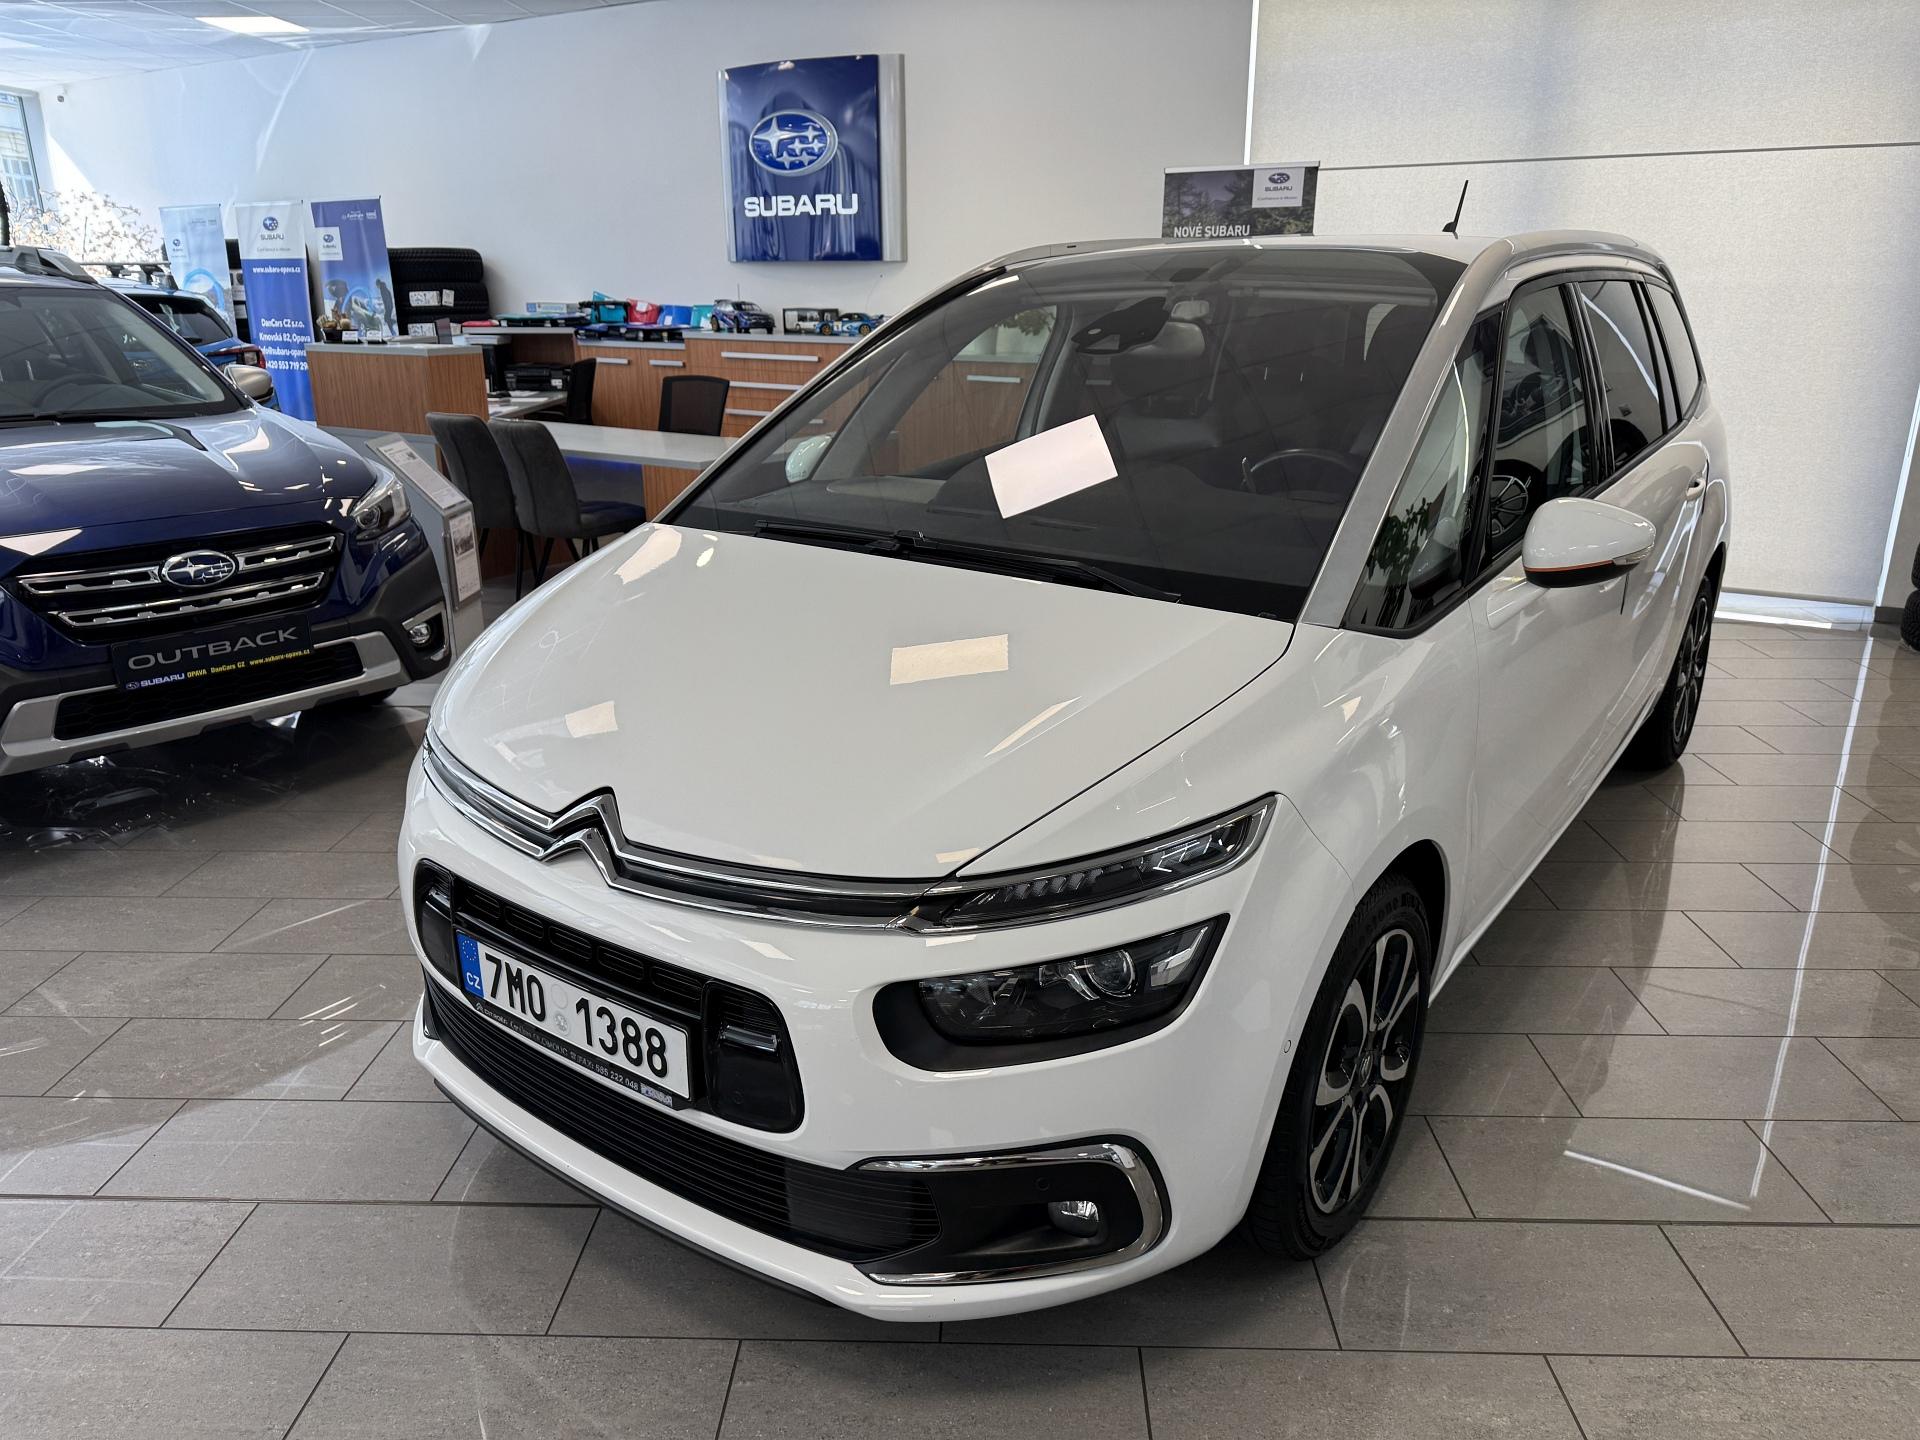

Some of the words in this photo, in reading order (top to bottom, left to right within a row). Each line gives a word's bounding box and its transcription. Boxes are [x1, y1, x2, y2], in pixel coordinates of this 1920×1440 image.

[744, 193, 859, 218] SUBARU
[1174, 223, 1202, 237] NOVÉ
[1204, 224, 1250, 237] SUBARU
[261, 318, 283, 328] DanCars
[283, 319, 291, 328] CZ
[292, 333, 311, 344] Opava
[278, 360, 289, 370] 553
[289, 361, 300, 370] 719
[127, 626, 299, 670] OUTBACK
[140, 672, 186, 688] SUBARU
[186, 668, 207, 679] OPAVA
[210, 664, 236, 674] DanCars
[237, 661, 246, 669] CZ
[466, 971, 481, 990] CZ
[484, 952, 546, 1022] 7M0
[575, 997, 669, 1079] 1388
[610, 1070, 624, 1084] 222
